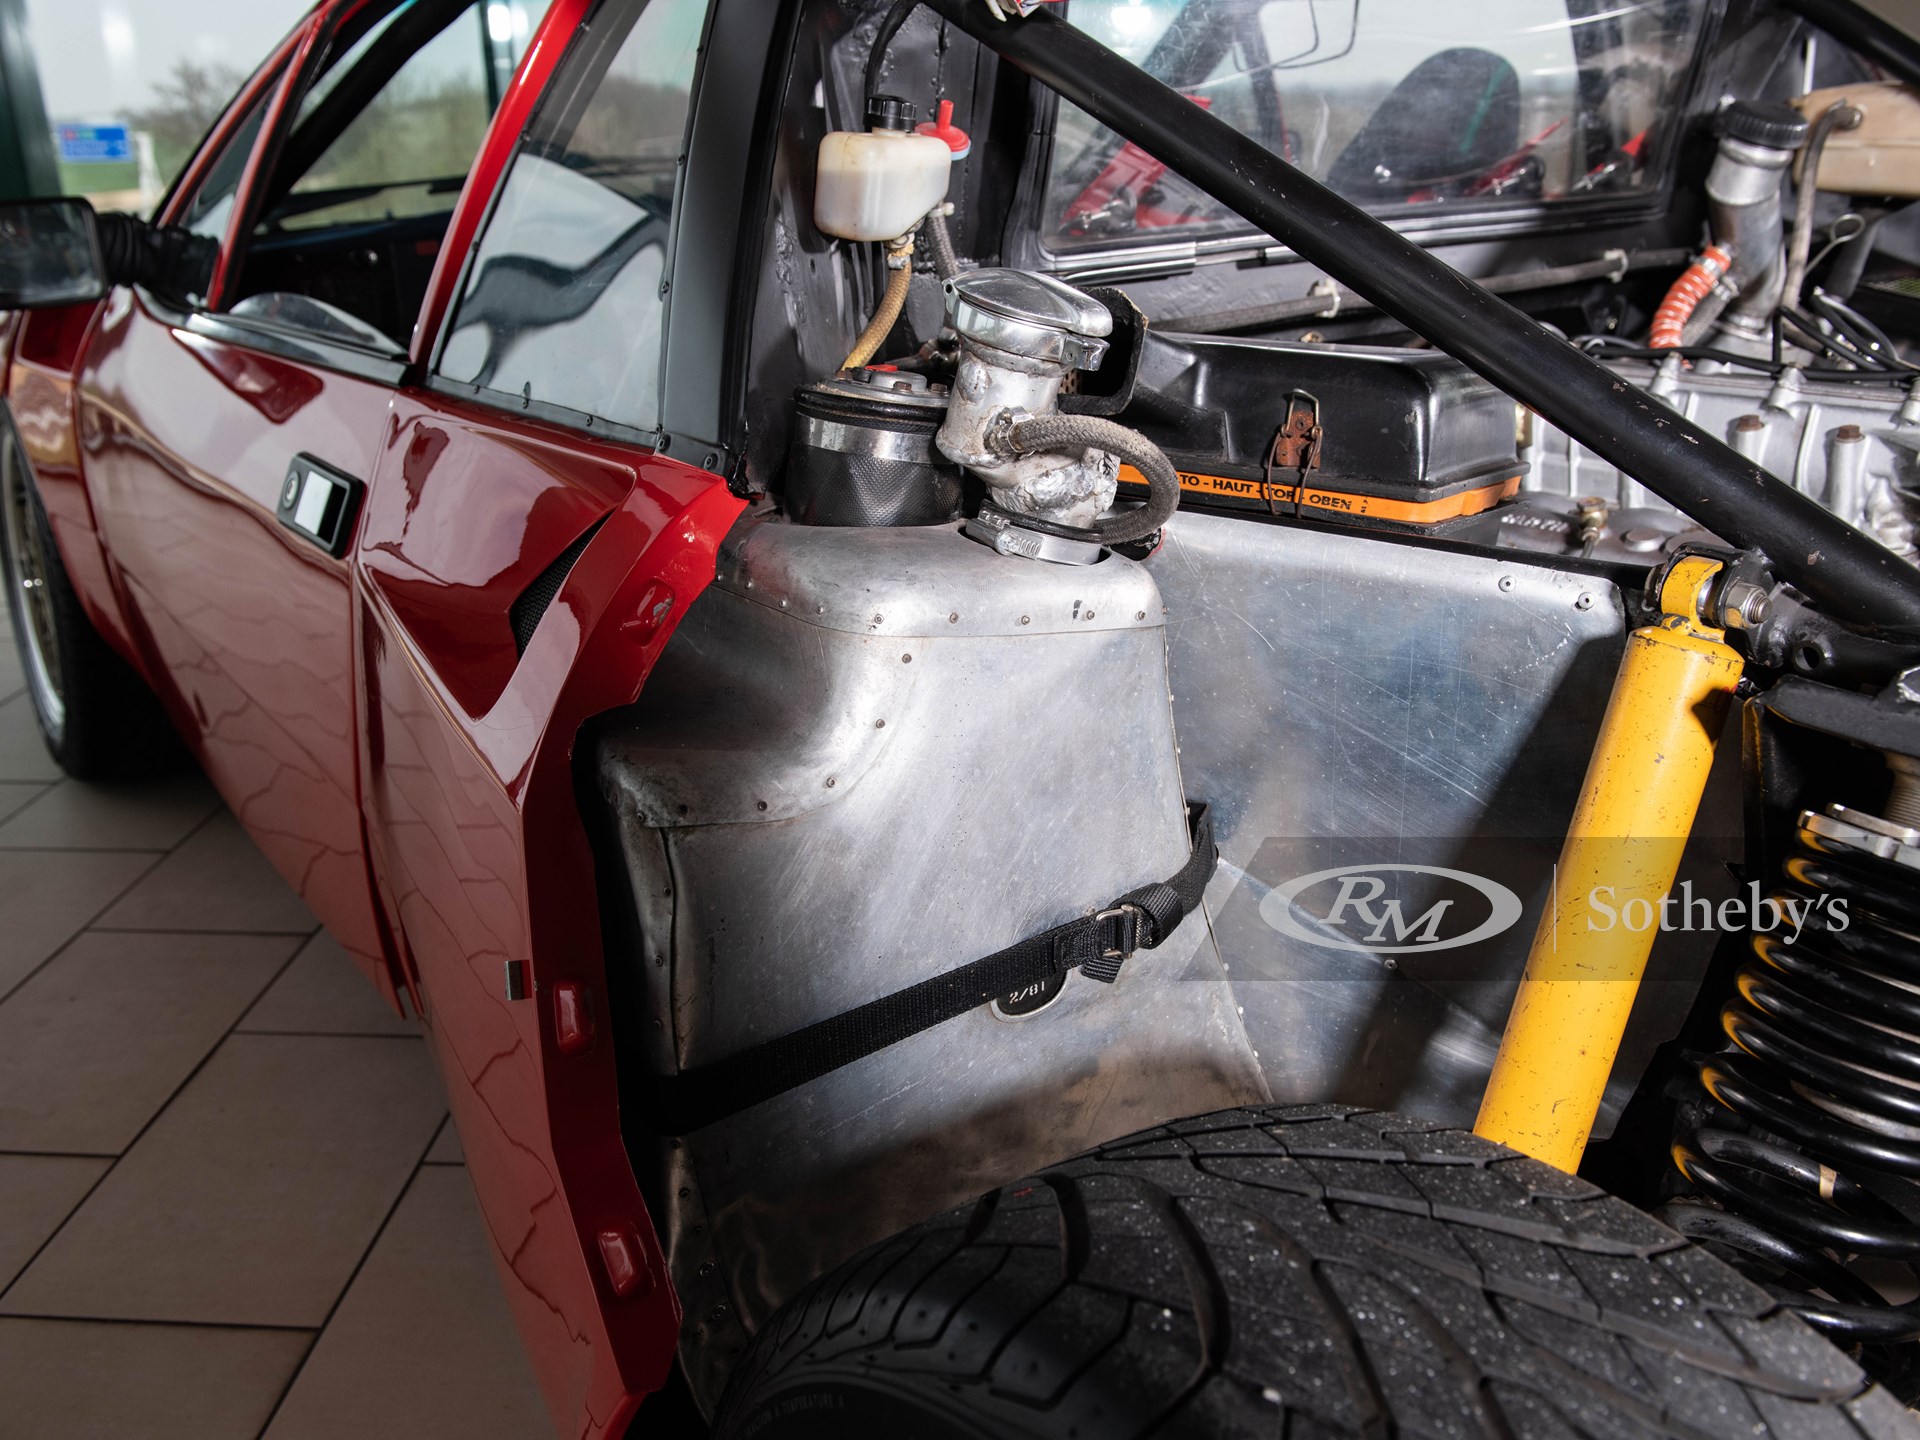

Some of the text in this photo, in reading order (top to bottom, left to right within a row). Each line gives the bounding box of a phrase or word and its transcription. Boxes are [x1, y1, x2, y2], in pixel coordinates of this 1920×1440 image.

[1179, 474, 1200, 486] TO
[1213, 479, 1253, 494] HAUT
[1309, 494, 1352, 510] OBEN
[1009, 981, 1045, 1004] 2/81
